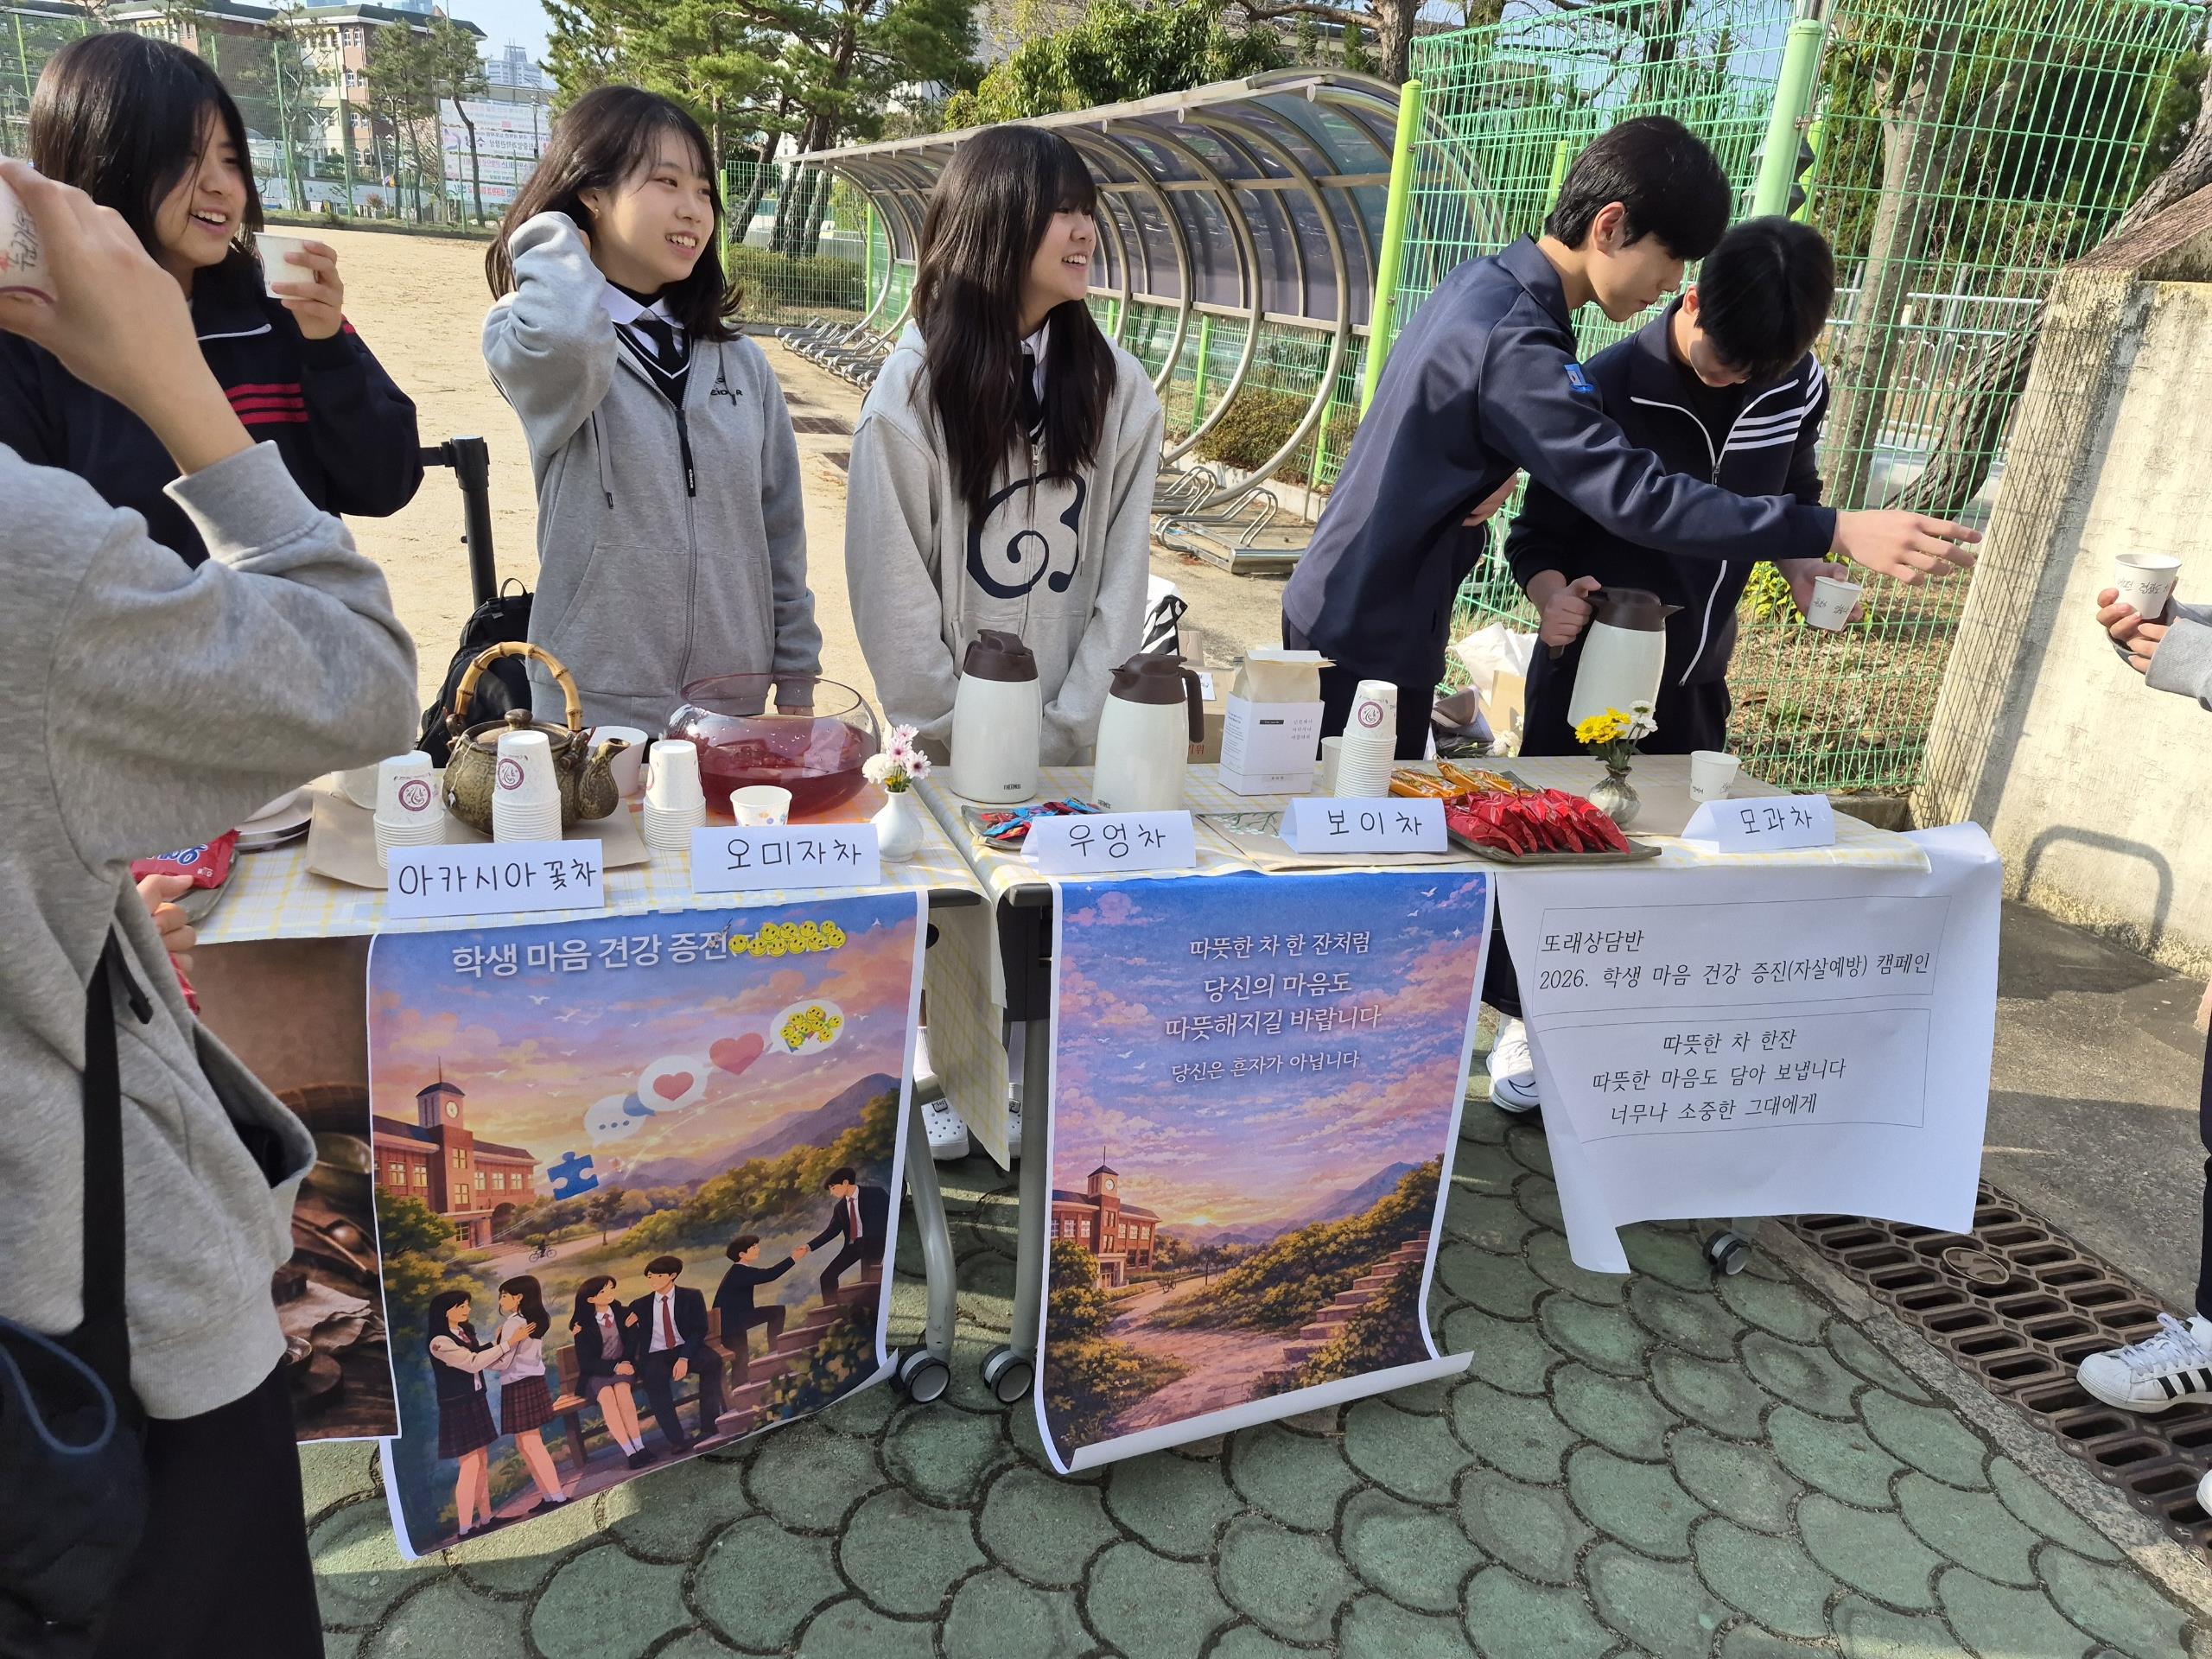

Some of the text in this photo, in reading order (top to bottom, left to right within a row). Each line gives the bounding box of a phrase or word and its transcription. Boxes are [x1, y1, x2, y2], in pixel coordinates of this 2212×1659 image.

[1328, 810, 1421, 835] 보이차
[1741, 807, 1812, 834] 모과차
[728, 839, 861, 869] 오미자차
[1070, 824, 1166, 858] 우엉차
[1190, 931, 1370, 960] 따뜻한 차 한 잔처럼
[1541, 931, 1644, 953] 또래상담반
[453, 944, 517, 977] 학생
[528, 940, 591, 972] 마음
[1540, 953, 1929, 988] 2026. 학생 마음 건강 증진(자살예방) 캠페인
[1203, 971, 1352, 1002] 당신의 마음도
[1165, 1005, 1382, 1042] 따뜻해지길 바랍니다
[1664, 1029, 1796, 1054] 따뜻한 차 한잔
[1173, 1051, 1359, 1082] 당신은 혼자가 아닙니다
[1593, 1058, 1846, 1091] 따뜻한 마음도 담아 보냅니다
[1612, 1094, 1816, 1123] 너무나 소중한 그대에게
